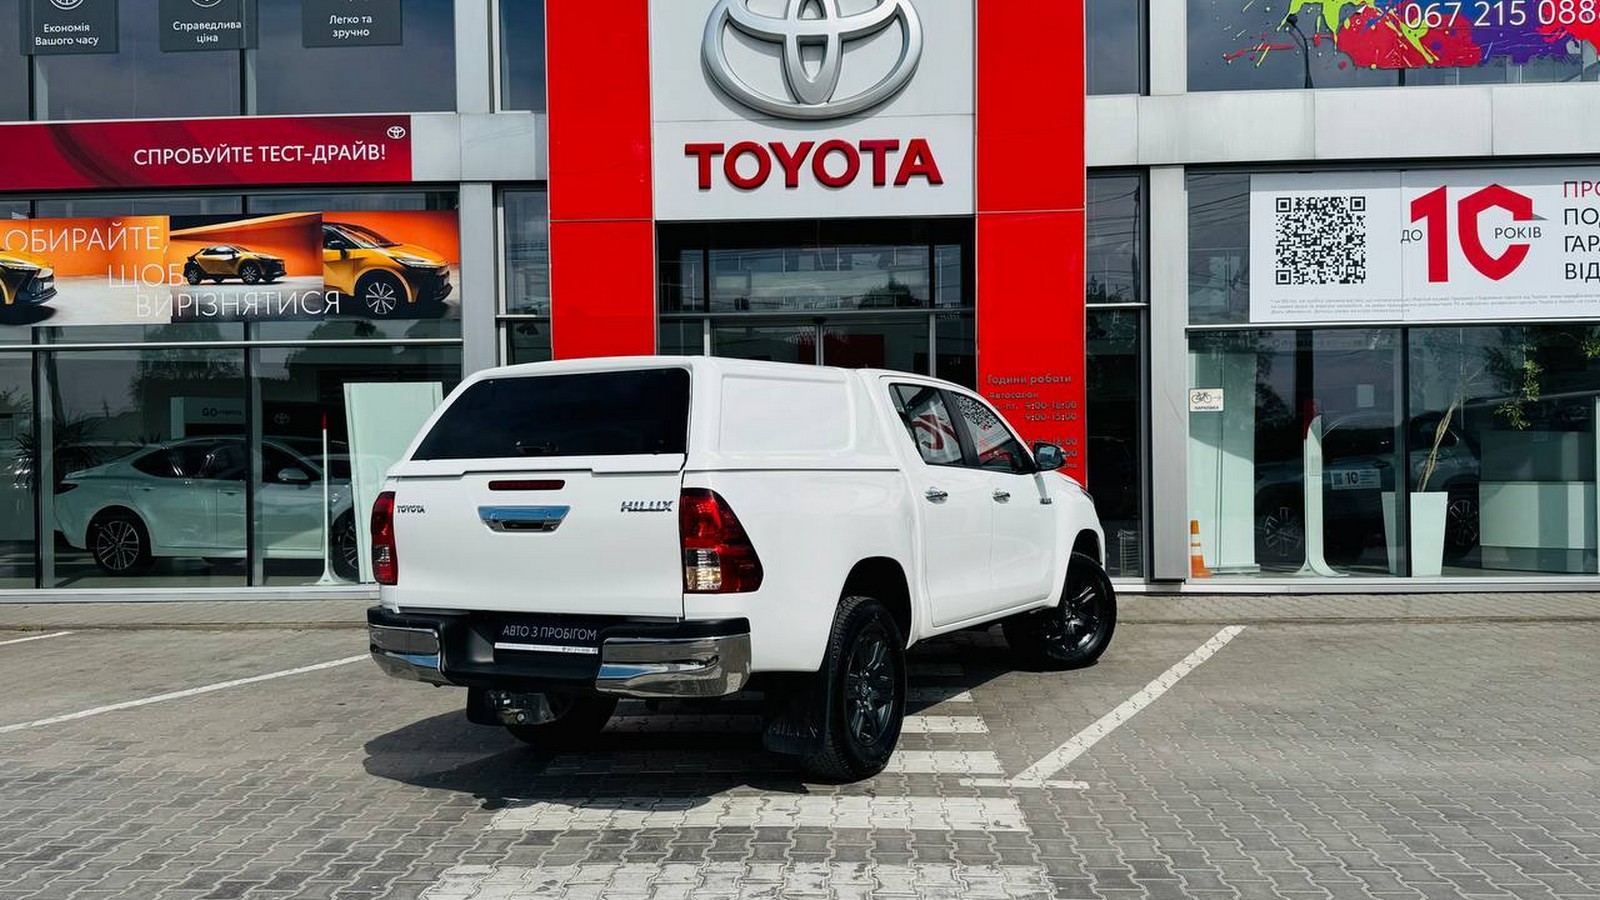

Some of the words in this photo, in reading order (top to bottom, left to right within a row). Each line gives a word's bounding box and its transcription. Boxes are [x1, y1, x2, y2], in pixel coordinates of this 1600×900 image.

[329, 15, 359, 25] Легко
[362, 16, 373, 24] та
[1404, 3, 1462, 28] 067
[1473, 1, 1527, 26] 215
[1538, 0, 1600, 24] 088
[43, 22, 90, 33] Економія
[173, 21, 242, 31] Справедлива
[332, 28, 370, 38] зручно
[35, 36, 74, 46] Вашого
[76, 36, 99, 46] часу
[197, 33, 219, 43] ціна
[133, 143, 254, 166] СПРОБУЙТЕ
[258, 141, 387, 165] ТЕСТ-ДРАЙВ!
[684, 138, 944, 191] TOYOTA
[1564, 207, 1600, 228] ПО
[1400, 229, 1424, 243] ДО
[1494, 227, 1542, 240] РОКІВ
[1564, 235, 1600, 252] ГАР
[108, 262, 184, 291] ЩОБ
[136, 290, 341, 318] ВИРІЗНЯТИСЯ
[987, 374, 1027, 386] Години
[1030, 373, 1072, 386] роботи
[396, 504, 426, 514] TOYOTA
[620, 500, 674, 513] HILUX
[502, 624, 530, 637] АВТО
[540, 626, 598, 641] ПРОБІГОМ
